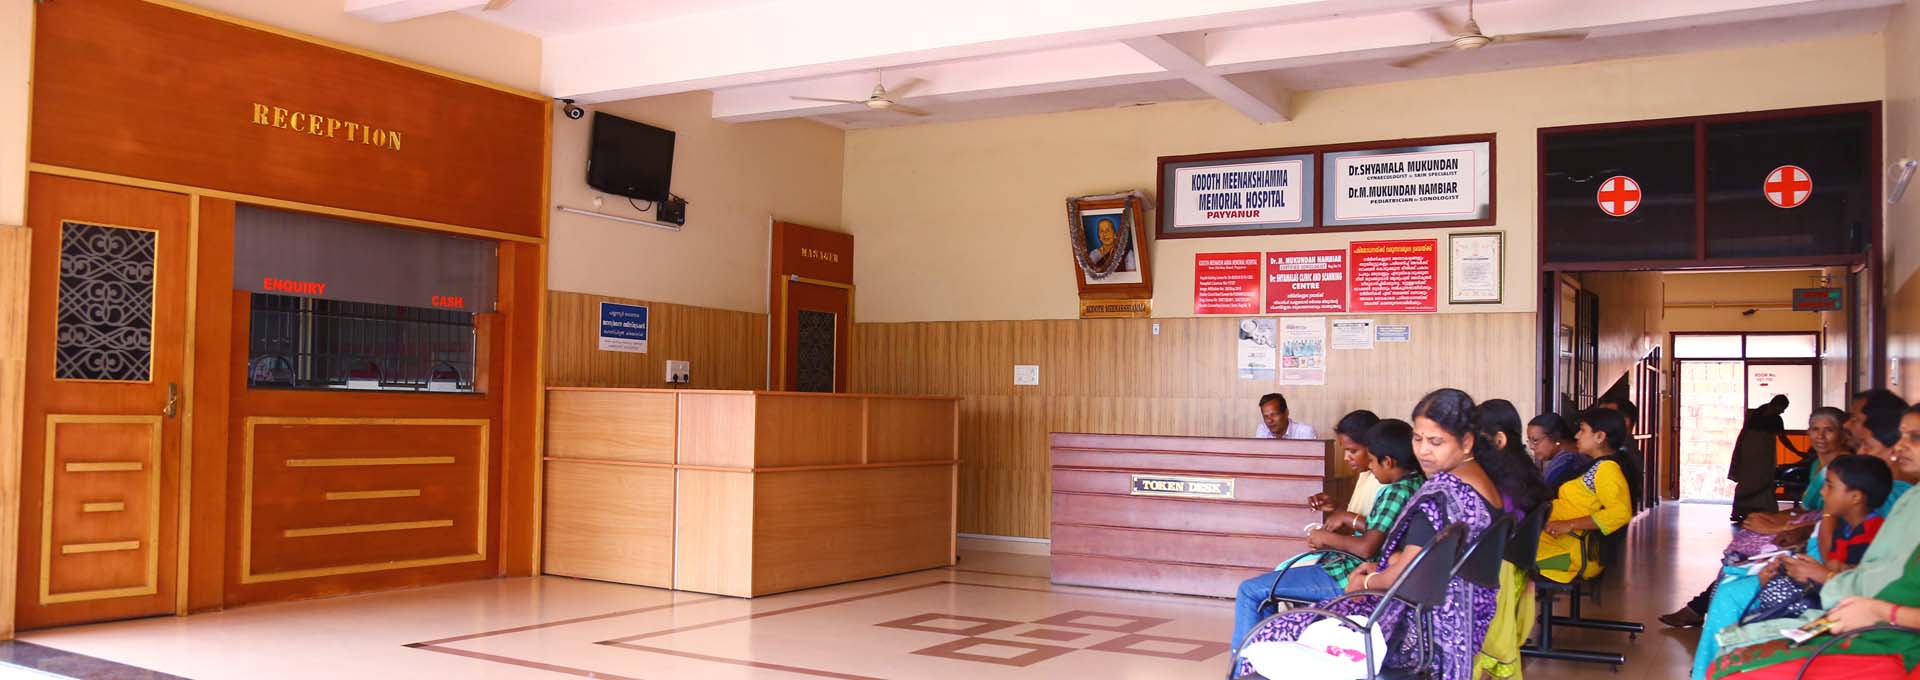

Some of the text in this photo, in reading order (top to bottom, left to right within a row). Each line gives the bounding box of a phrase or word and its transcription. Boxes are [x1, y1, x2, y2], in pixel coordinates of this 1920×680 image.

[252, 102, 402, 151] RECEPTION
[1348, 158, 1459, 176] Dr.SHYAMALA MUKUNDAN
[1191, 169, 1288, 191] KODOTH MEENAKSHIAMMA
[1418, 182, 1458, 195] NAMBIAR
[1199, 190, 1285, 211] MEMORIAL HOSPITAL
[1207, 209, 1260, 219] PAYYANUR
[263, 278, 326, 295] ENQUIRY
[1291, 282, 1320, 290] CENTRE
[431, 295, 464, 308] CASH
[1142, 480, 1221, 493] TOKEN DESK
